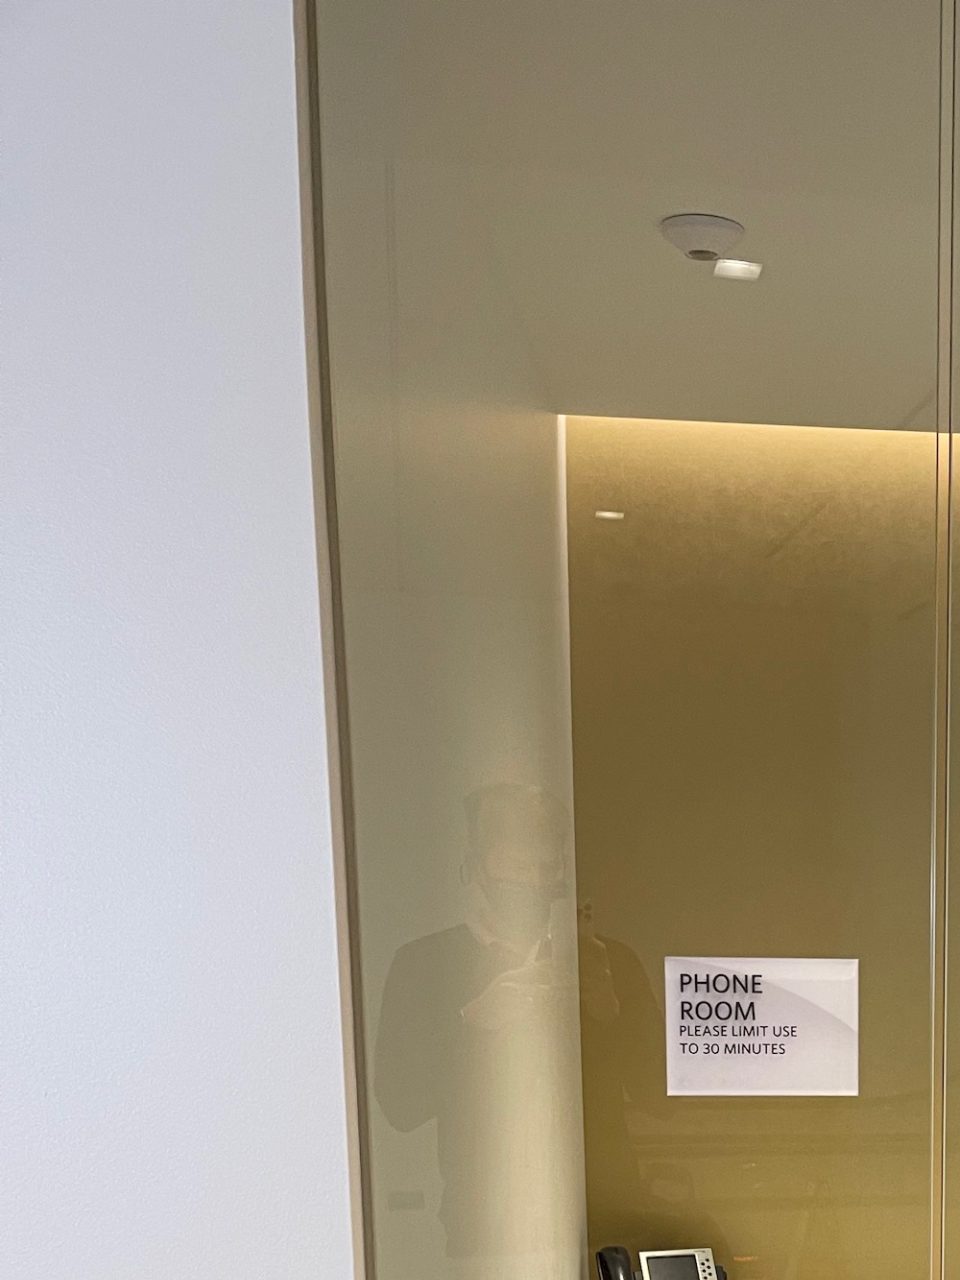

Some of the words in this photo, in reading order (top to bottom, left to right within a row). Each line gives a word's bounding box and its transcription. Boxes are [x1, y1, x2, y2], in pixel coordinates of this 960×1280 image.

[680, 973, 763, 994] PHONE
[680, 1001, 756, 1021] ROOM
[679, 1025, 728, 1037] PLEASE
[731, 1025, 769, 1037] LIMIT
[772, 1026, 797, 1038] USE
[680, 1043, 699, 1055] TO
[702, 1043, 720, 1055] 30
[724, 1043, 786, 1055] MINUTES
